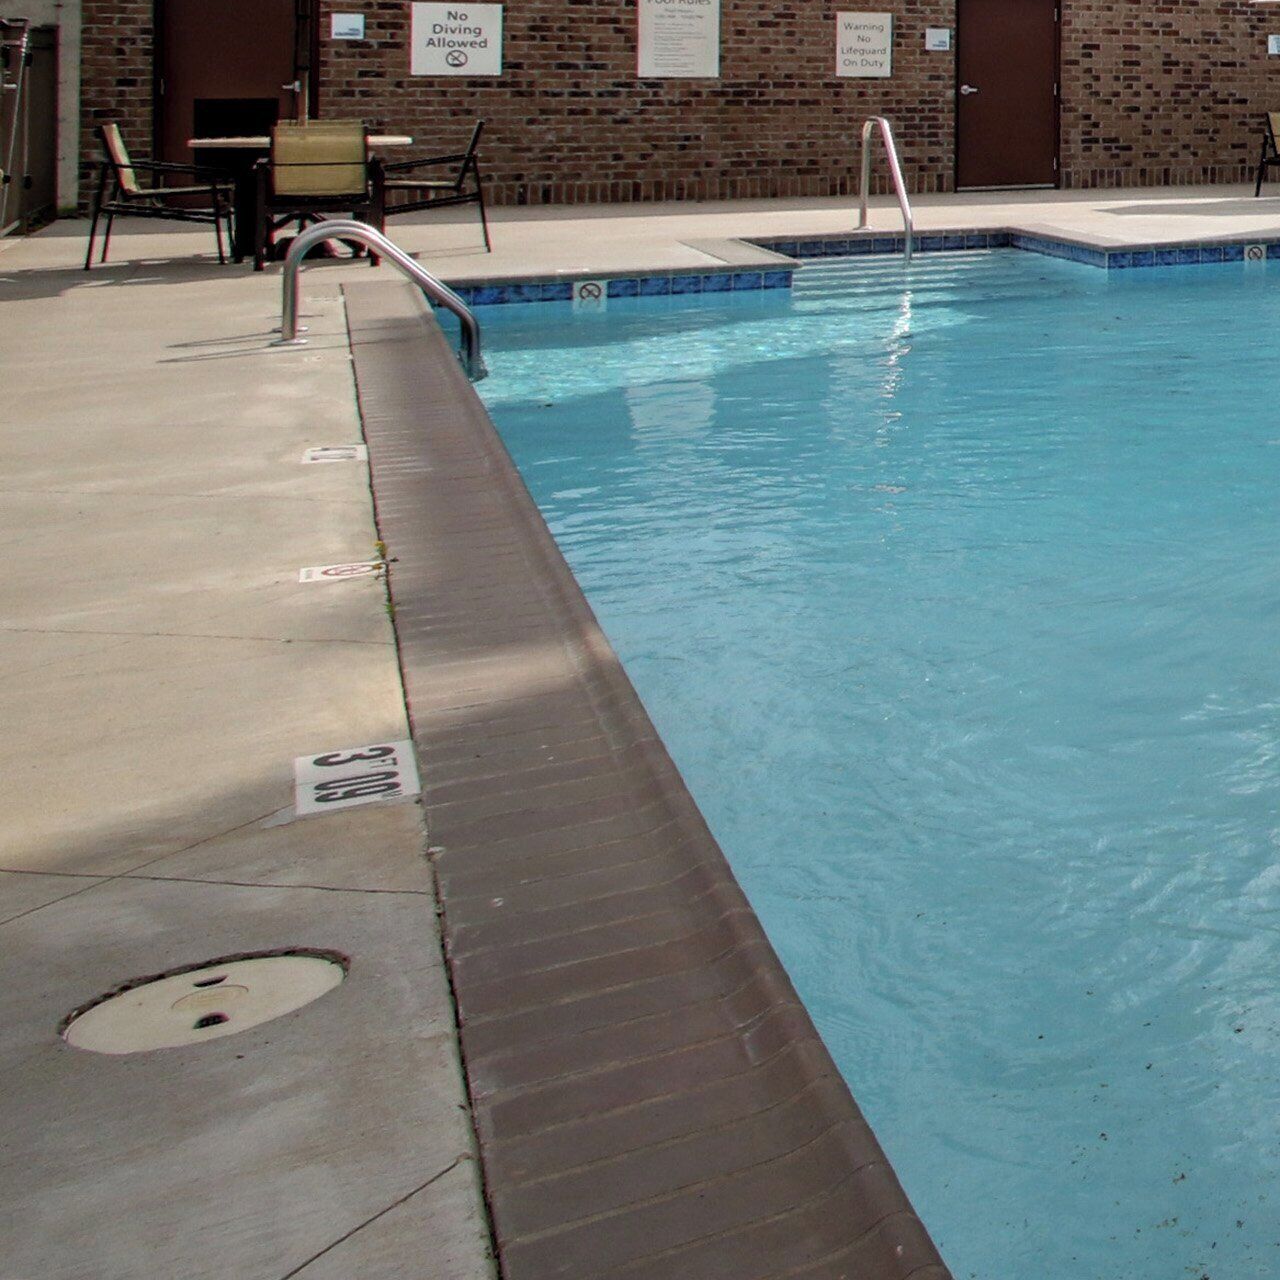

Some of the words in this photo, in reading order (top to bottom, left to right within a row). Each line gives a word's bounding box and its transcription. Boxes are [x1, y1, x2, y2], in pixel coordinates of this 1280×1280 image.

[447, 11, 468, 21] No
[432, 23, 482, 38] Diving
[843, 22, 884, 33] Warning
[425, 37, 488, 49] Allowed
[857, 35, 871, 43] No
[841, 47, 887, 56] Lifeguard
[843, 59, 857, 67] On
[861, 60, 884, 68] Duty
[312, 746, 395, 767] 3
